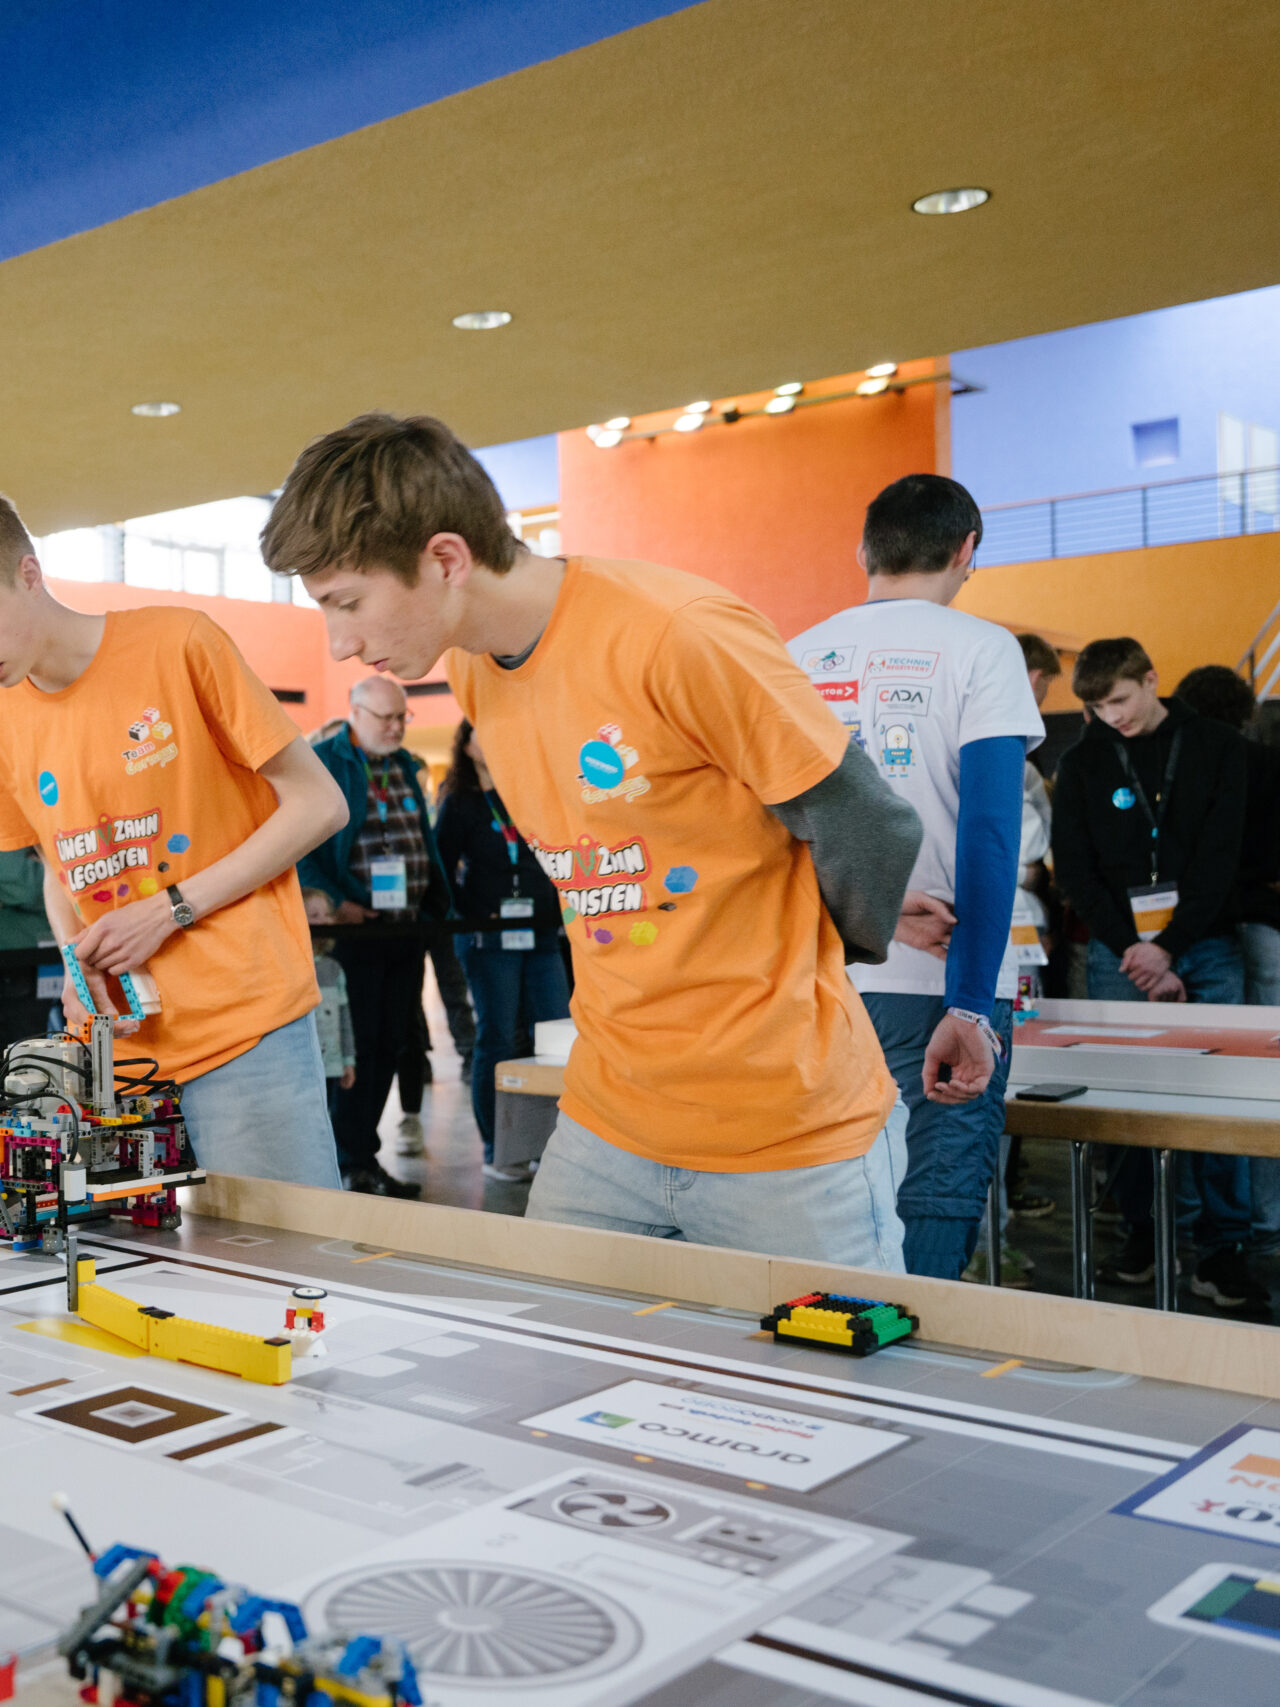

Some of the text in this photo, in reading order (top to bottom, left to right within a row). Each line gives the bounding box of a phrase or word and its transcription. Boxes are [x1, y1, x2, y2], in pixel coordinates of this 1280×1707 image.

[889, 657, 932, 667] TECHNIK
[879, 689, 924, 704] CADA
[122, 742, 155, 760] Team
[113, 813, 158, 843] ZAHN
[67, 847, 148, 892] LEGOISTEN
[638, 1422, 811, 1465] aramco
